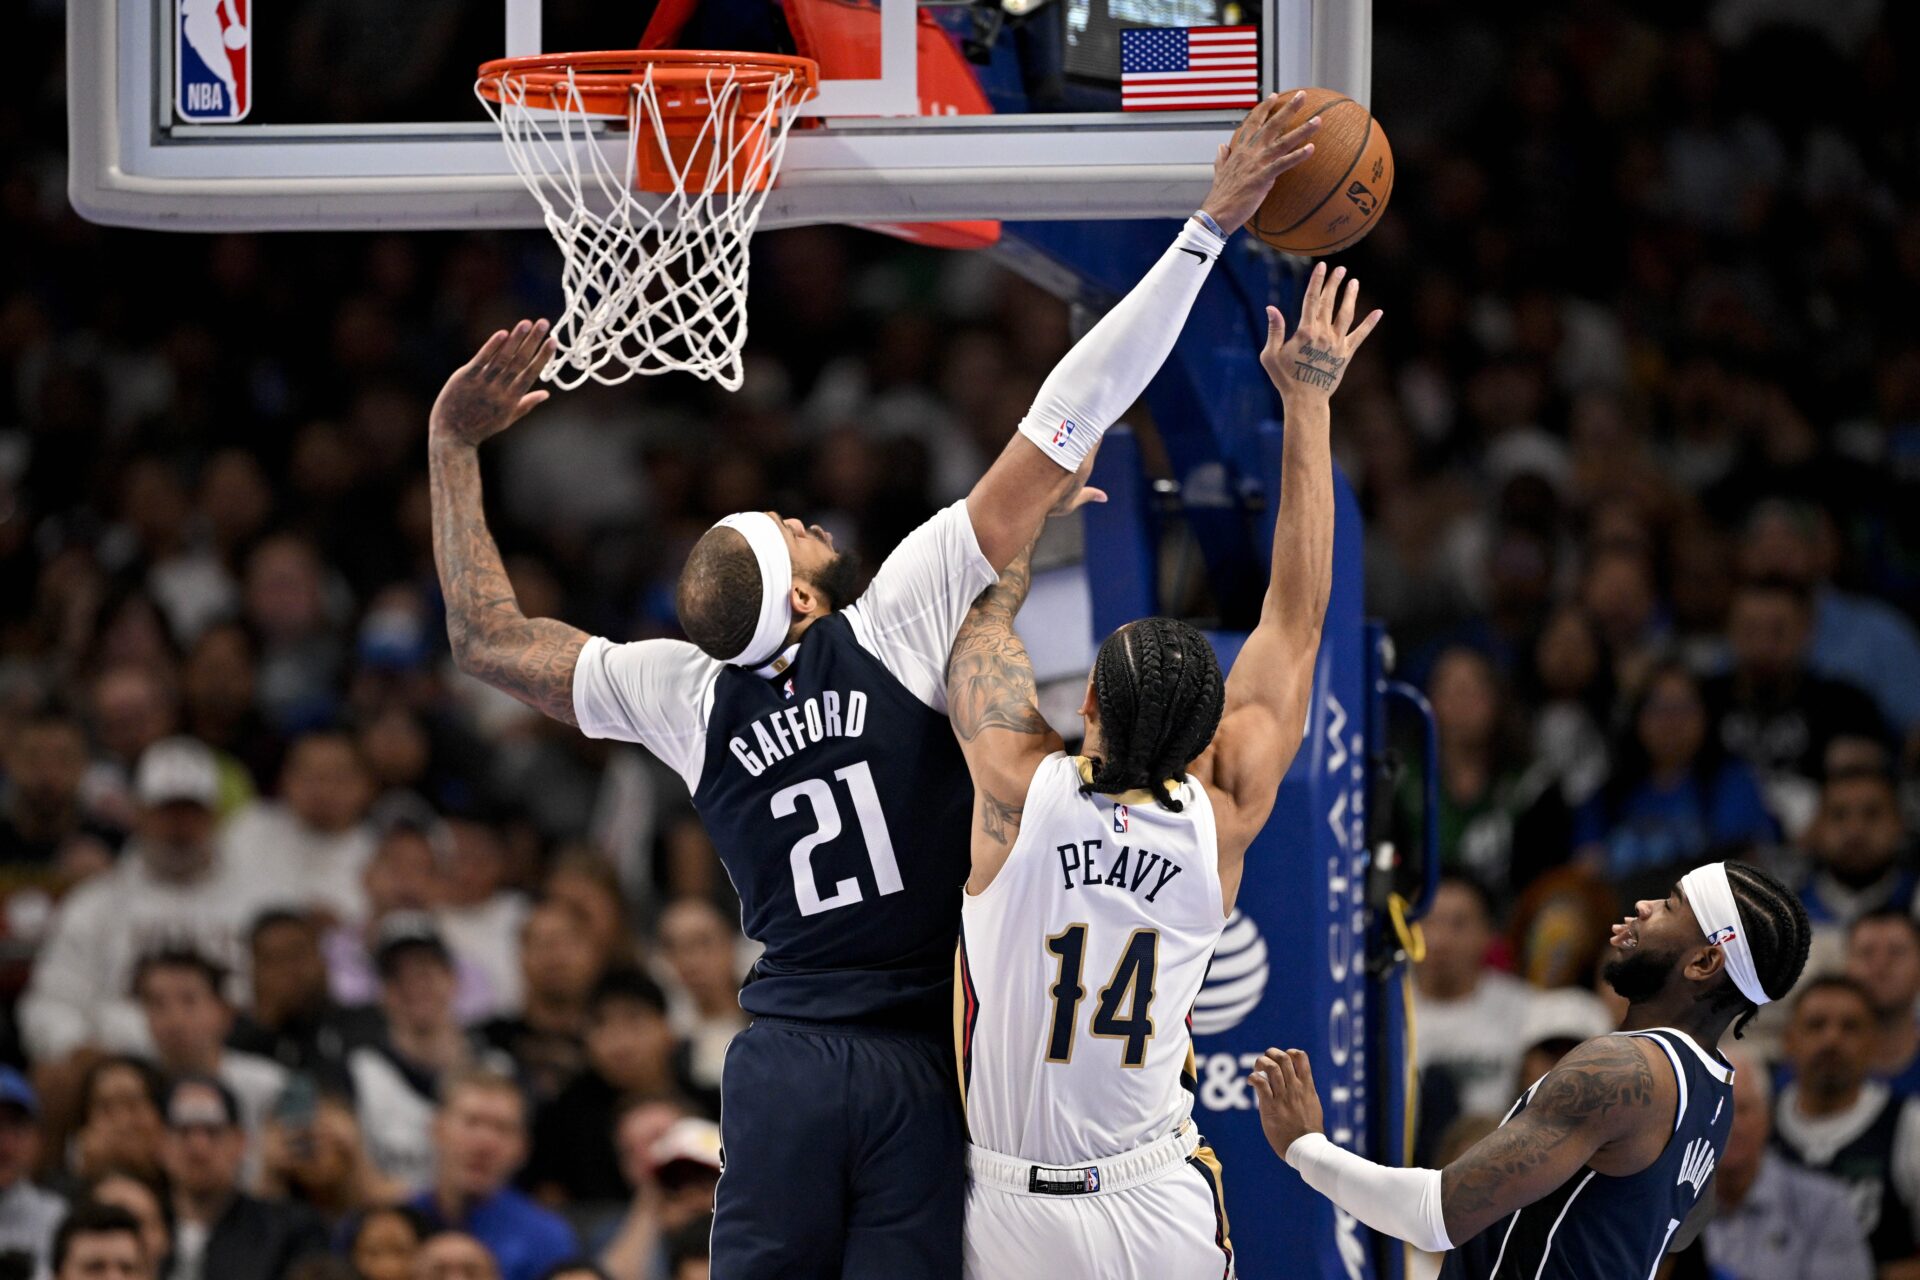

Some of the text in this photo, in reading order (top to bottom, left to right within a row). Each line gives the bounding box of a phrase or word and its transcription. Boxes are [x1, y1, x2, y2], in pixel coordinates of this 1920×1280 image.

[187, 82, 223, 111] NBA
[729, 690, 867, 777] GAFFORD
[770, 760, 904, 917] 21
[1057, 839, 1182, 903] PEAVY
[1045, 922, 1160, 1069] 14
